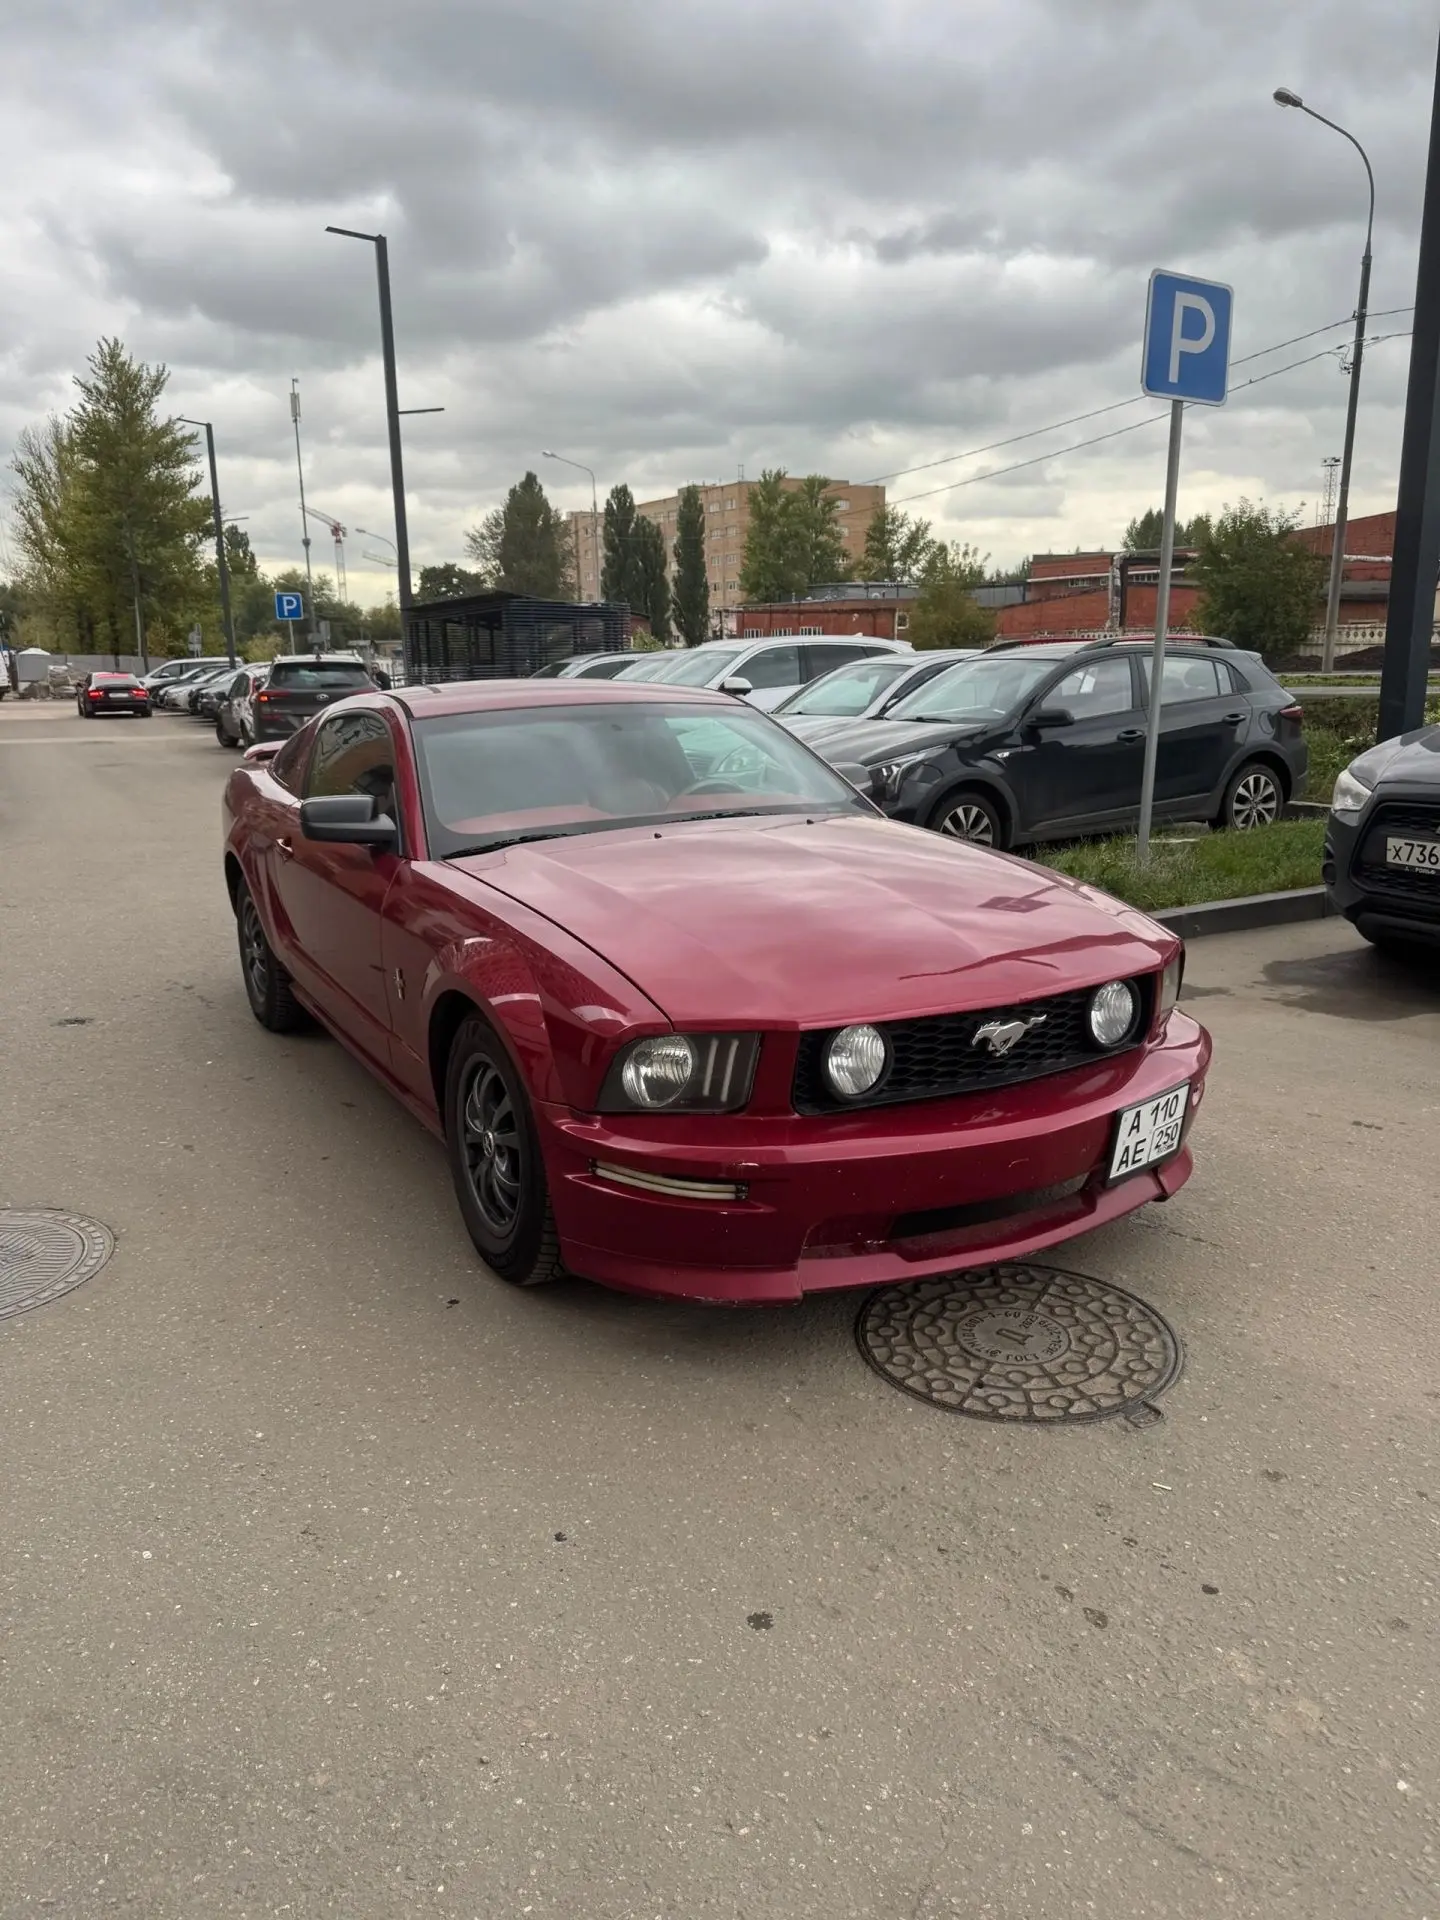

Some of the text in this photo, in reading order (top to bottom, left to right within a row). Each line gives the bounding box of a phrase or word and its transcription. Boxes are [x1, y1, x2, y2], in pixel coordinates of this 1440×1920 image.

[1168, 290, 1216, 384] P
[282, 596, 297, 616] P
[1150, 1093, 1179, 1127] 110
[1155, 1122, 1179, 1150] 250
